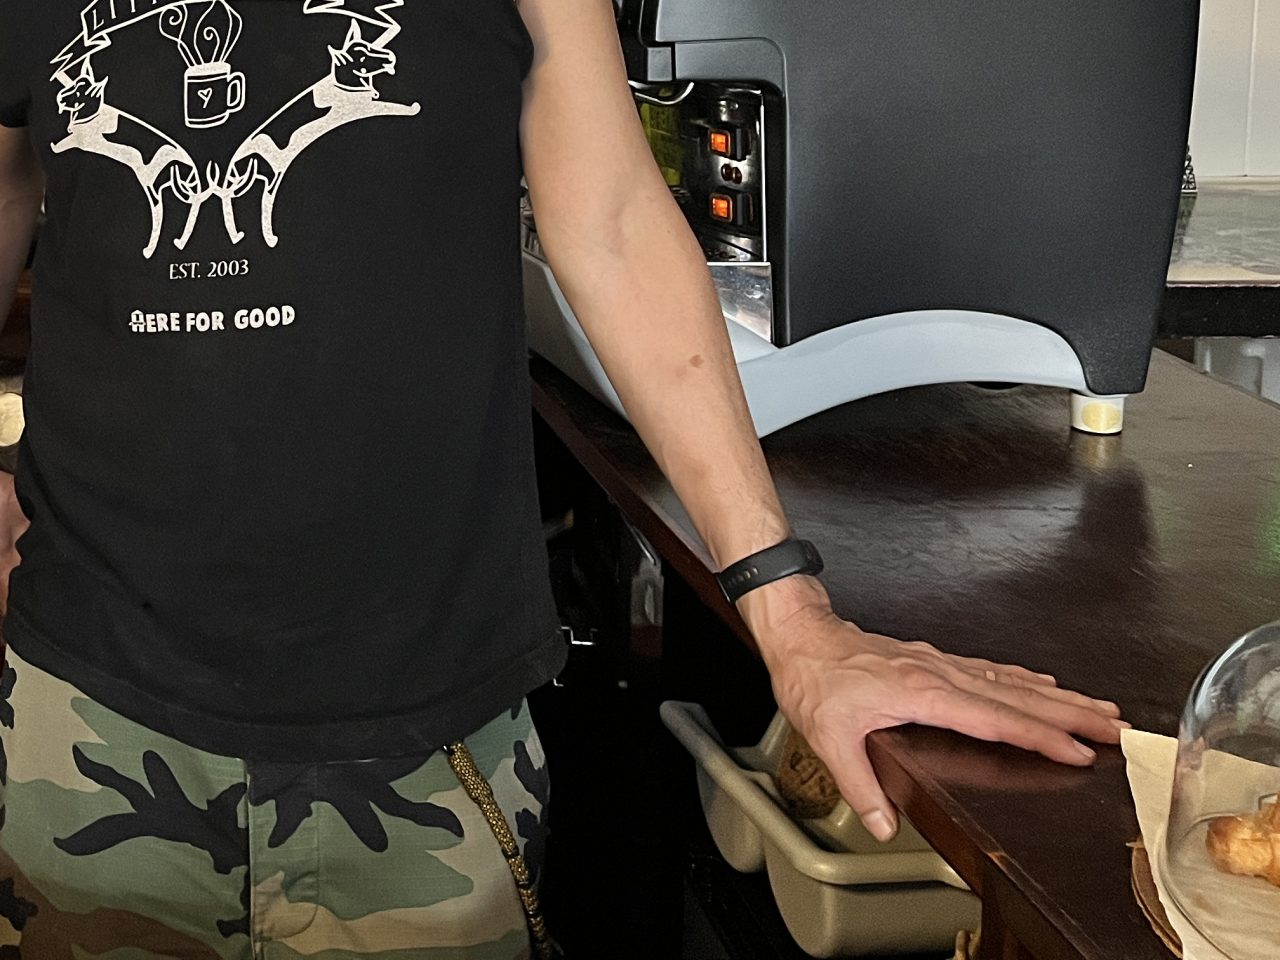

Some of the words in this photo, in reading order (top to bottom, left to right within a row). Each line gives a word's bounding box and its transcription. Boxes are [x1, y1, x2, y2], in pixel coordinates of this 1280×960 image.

[169, 263, 201, 279] EST.
[207, 259, 249, 277] 2003
[129, 309, 181, 333] HERE
[186, 311, 224, 332] FOR
[234, 305, 295, 330] GOOD
